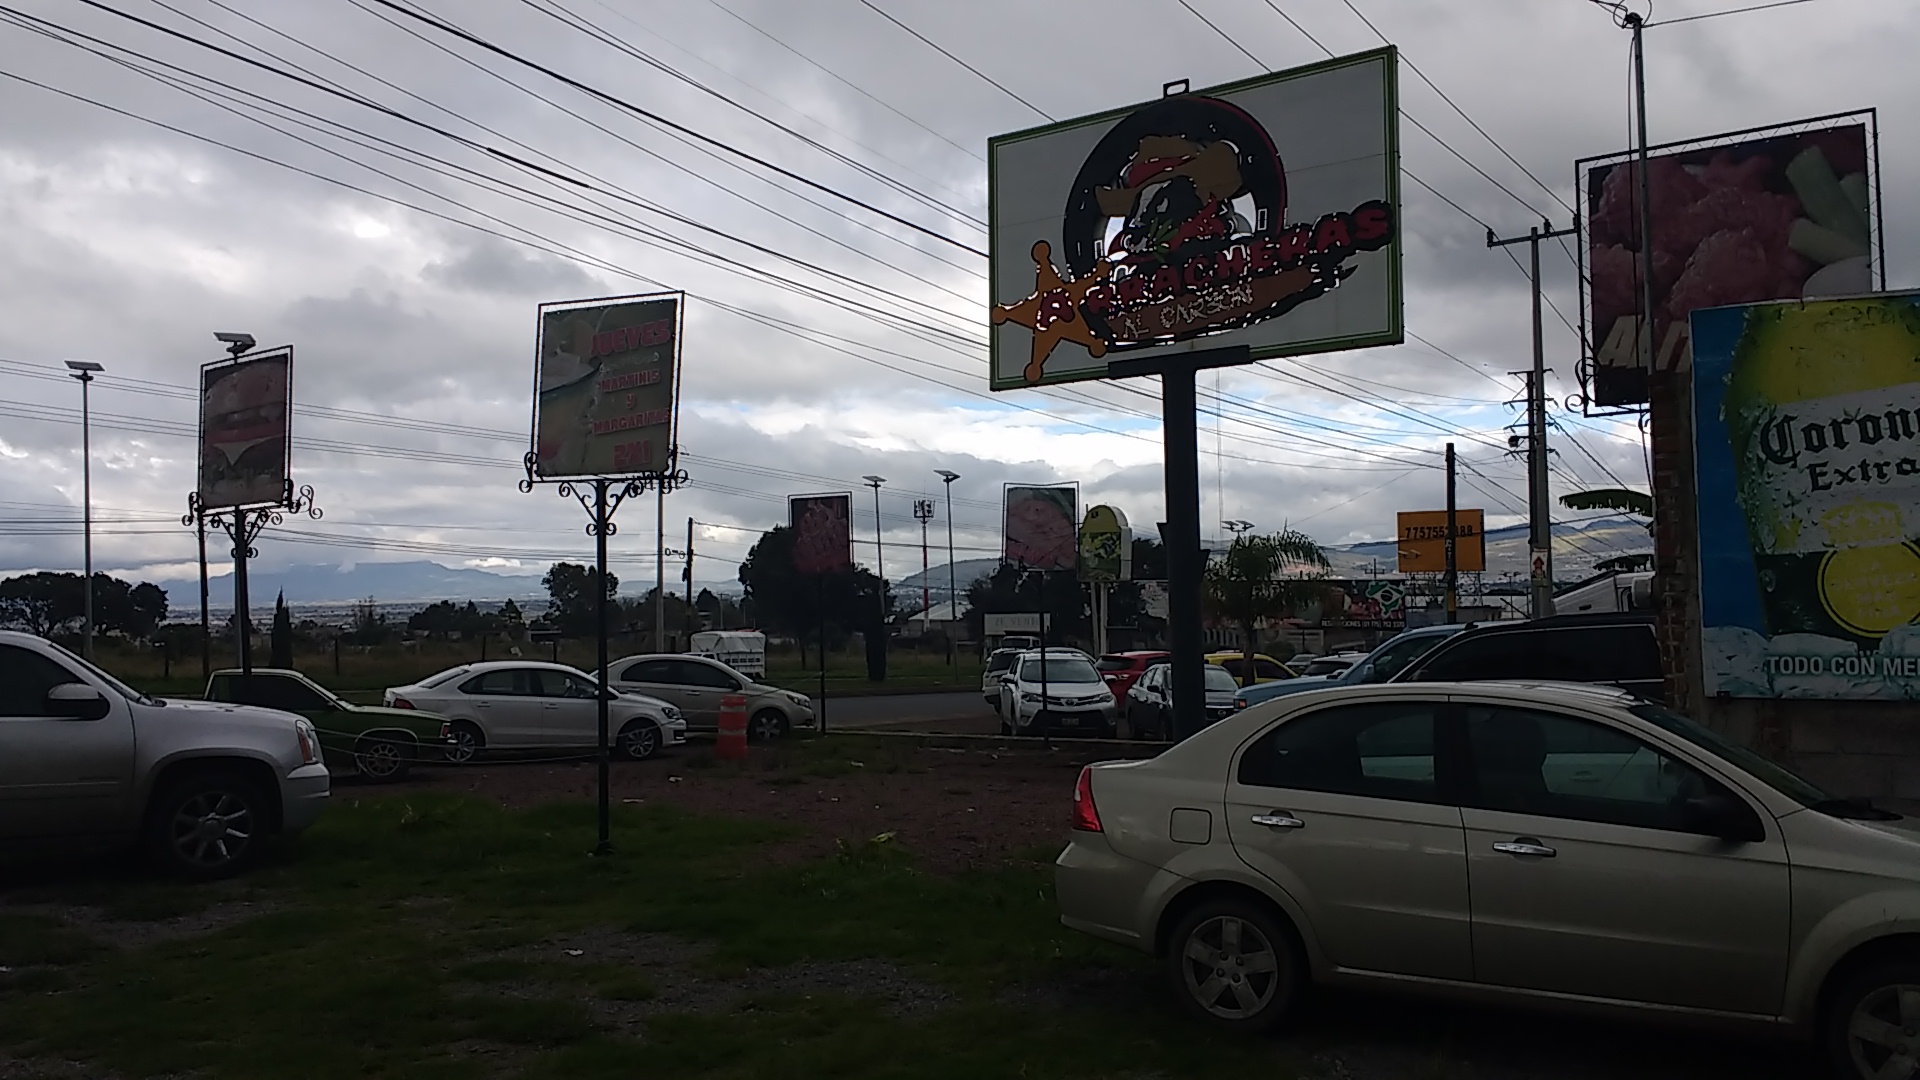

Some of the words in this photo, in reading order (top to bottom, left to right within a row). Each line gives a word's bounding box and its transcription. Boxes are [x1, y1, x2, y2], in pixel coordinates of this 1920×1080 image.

[591, 318, 671, 356] JUEVES
[601, 368, 661, 392] MARTINIS
[1760, 408, 1920, 469] Coron
[1805, 457, 1920, 492] Extra
[1767, 656, 1824, 675] TODO
[1830, 656, 1876, 676] CON
[1882, 657, 1920, 676] ME
